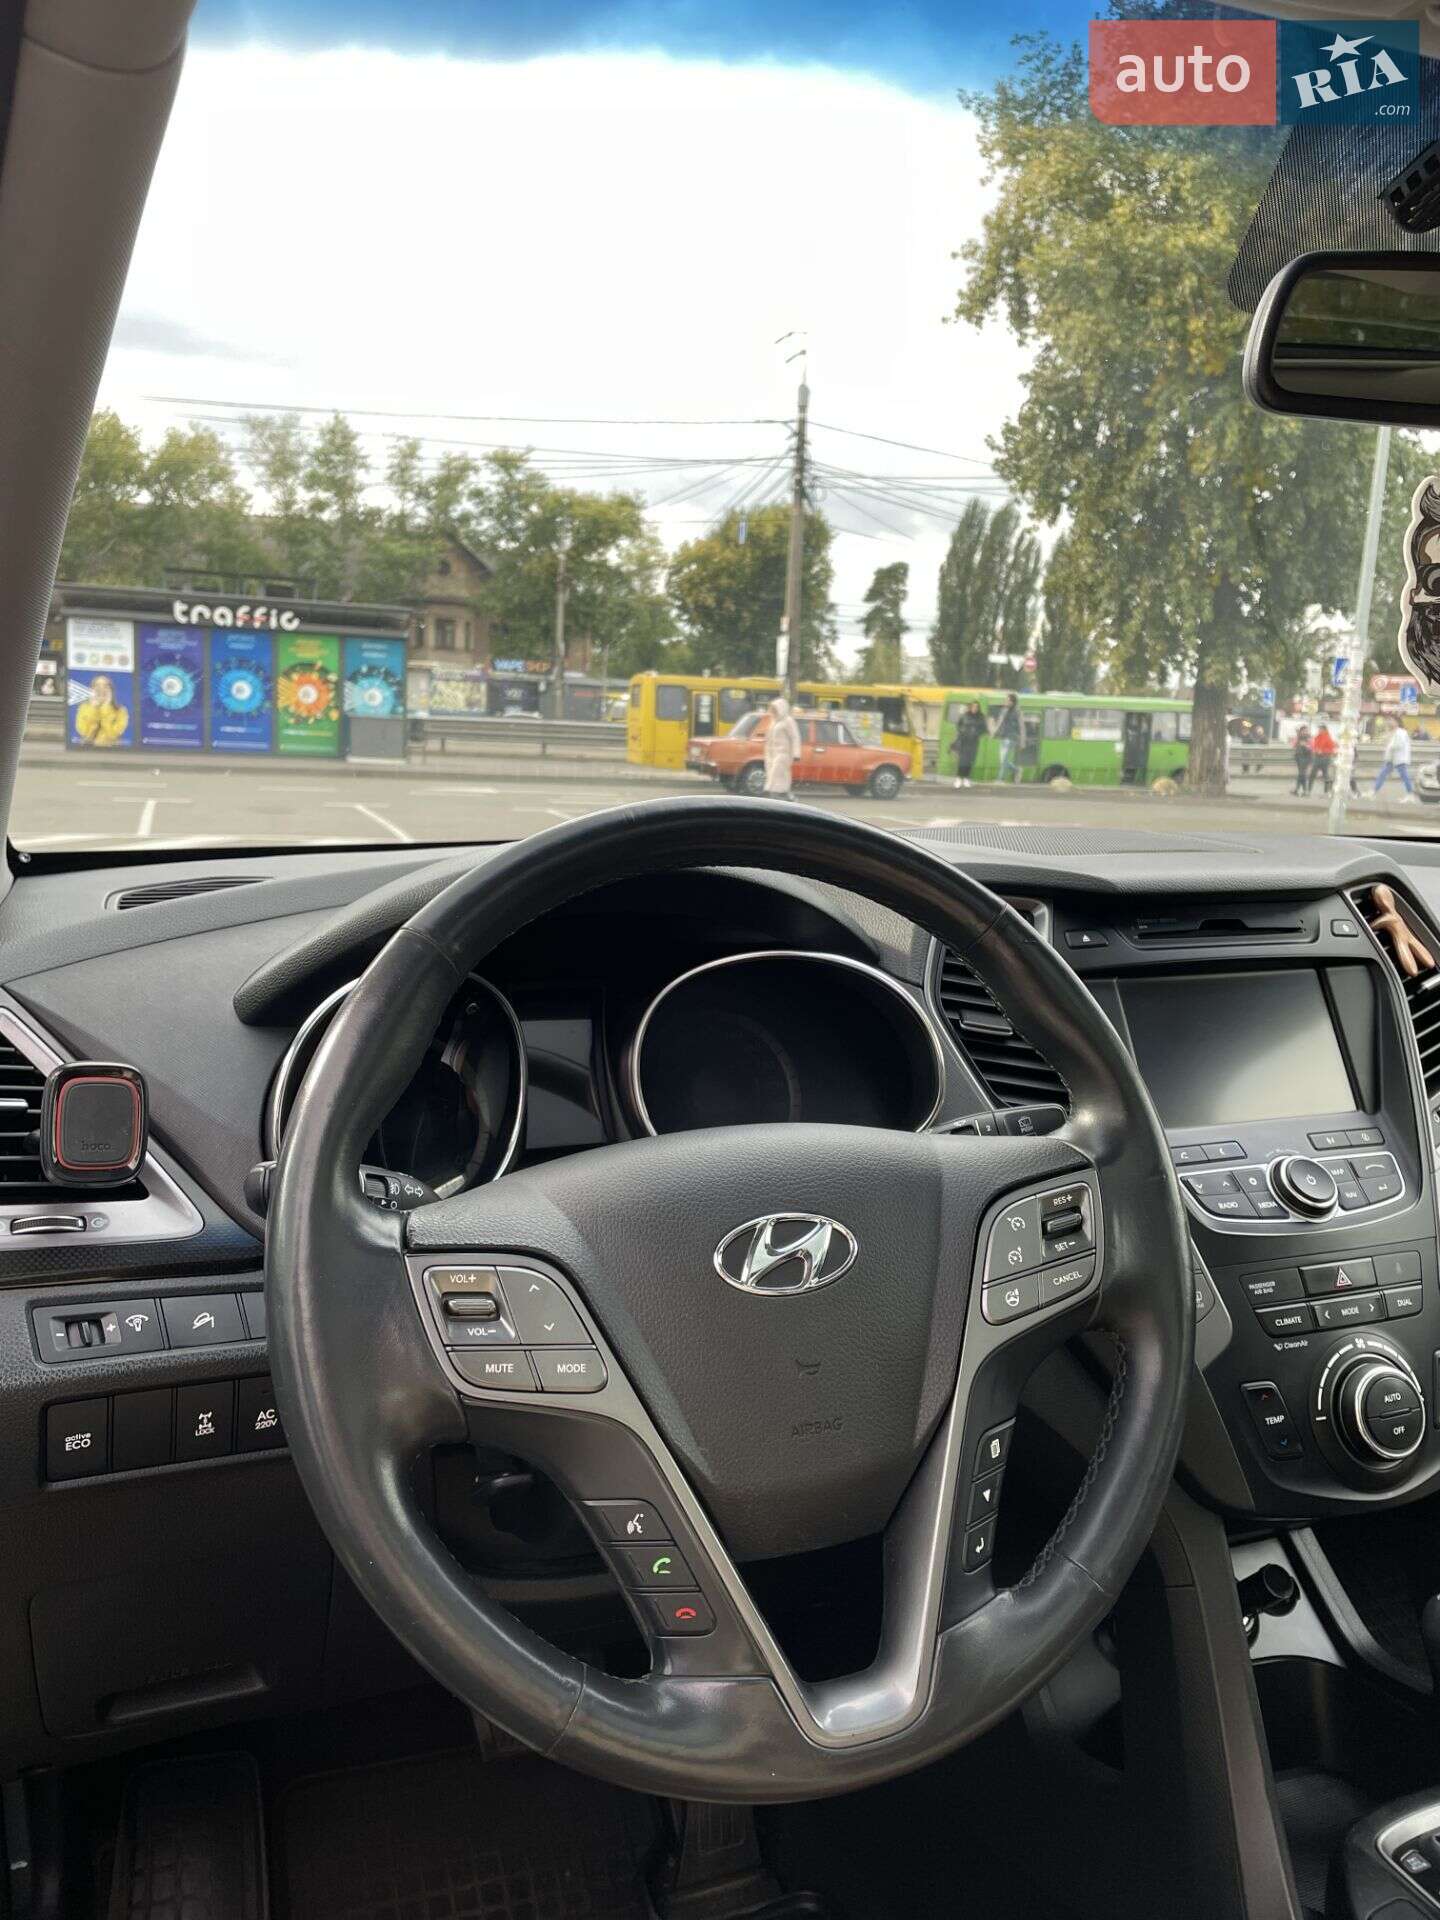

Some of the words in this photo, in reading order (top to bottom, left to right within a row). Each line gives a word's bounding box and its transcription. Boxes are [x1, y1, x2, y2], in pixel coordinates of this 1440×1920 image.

[172, 600, 301, 632] traffic
[1218, 1201, 1239, 1209] RADIO
[1258, 1201, 1278, 1209] MEDIA
[450, 1275, 477, 1284] VOL+
[1053, 1271, 1082, 1285] CANCEL
[1397, 1299, 1412, 1307] DUAL
[1341, 1306, 1359, 1316] MODE
[1275, 1316, 1303, 1327] CLIMATE
[485, 1364, 514, 1373] MUTE
[557, 1364, 586, 1373] MODE
[1384, 1393, 1402, 1403] AUTO
[257, 1409, 276, 1421] AC
[1265, 1415, 1285, 1425] TEMP
[255, 1418, 278, 1430] 220V
[791, 1417, 844, 1437] AIRBAG
[195, 1427, 215, 1437] LOCK
[1393, 1426, 1406, 1436] OFF
[65, 1432, 91, 1443] active
[65, 1439, 92, 1452] ECO
